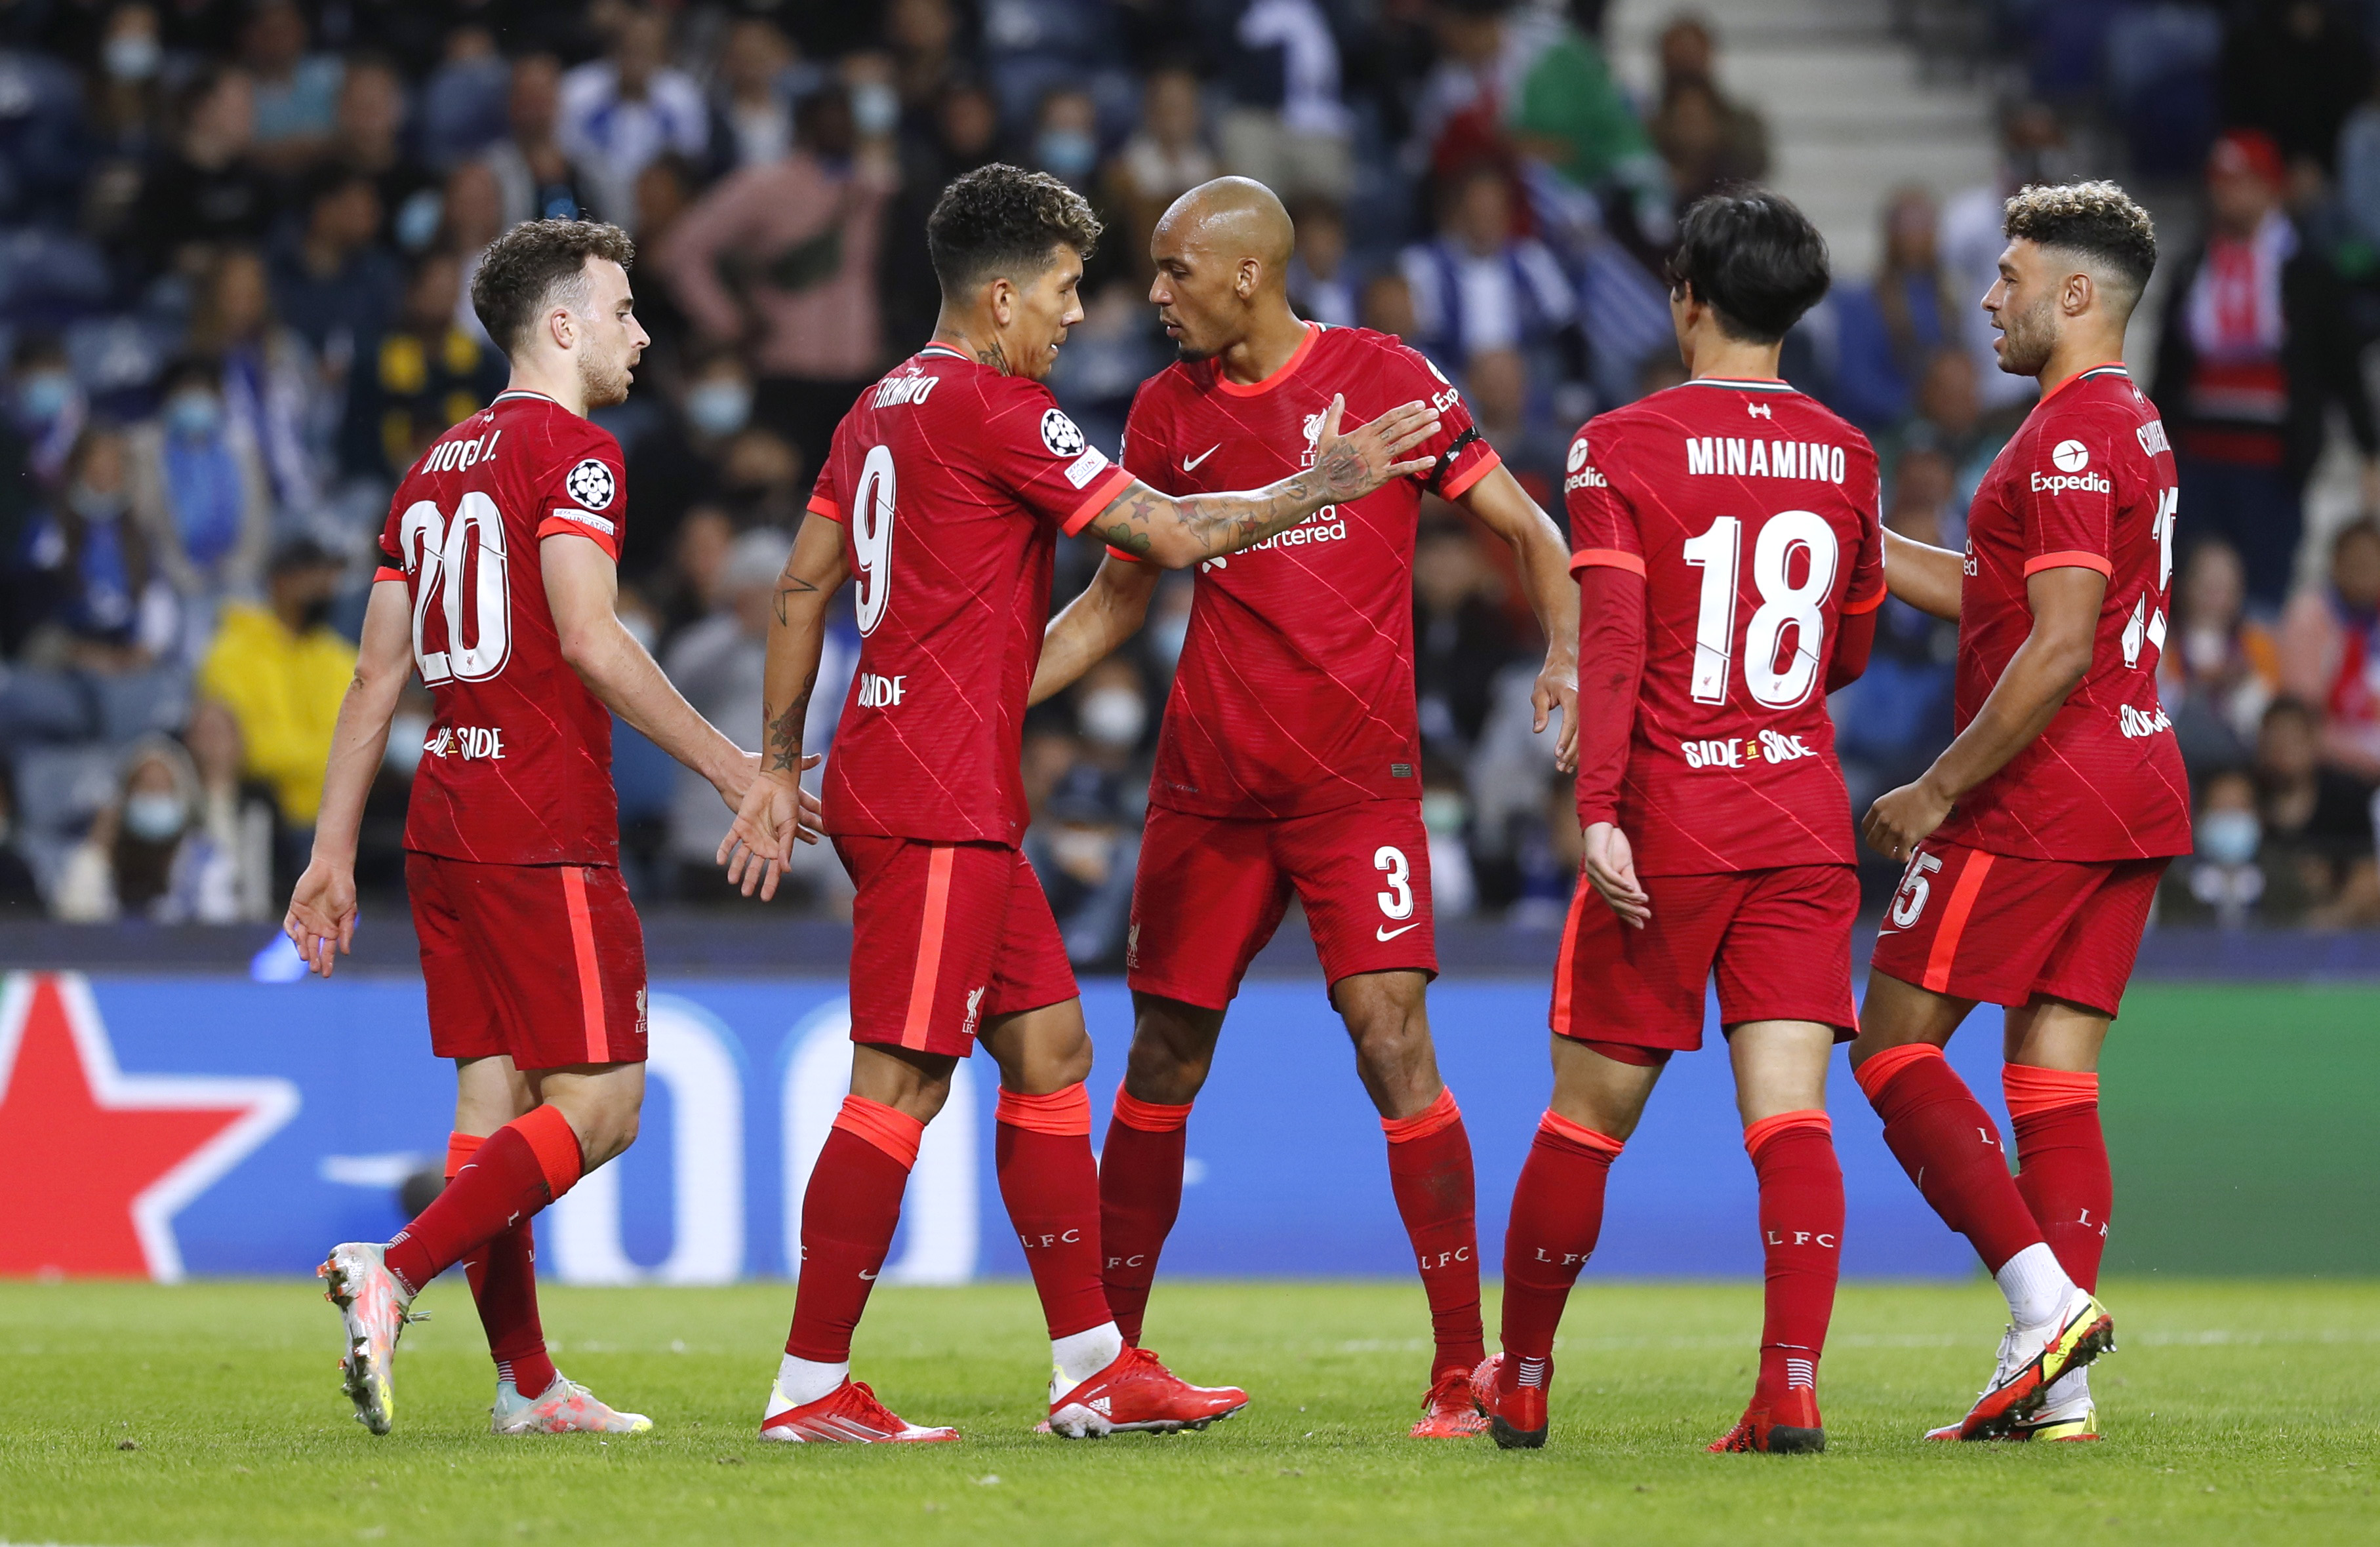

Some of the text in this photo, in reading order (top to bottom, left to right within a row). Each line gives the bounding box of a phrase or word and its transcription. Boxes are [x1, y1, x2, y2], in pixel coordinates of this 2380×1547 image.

[1432, 388, 1460, 412] Exp
[481, 430, 502, 462] J.
[1686, 437, 1846, 485] MINAMINO
[2030, 471, 2110, 496] Expedia
[852, 445, 897, 638] 9
[401, 492, 512, 687] 20
[1683, 510, 1838, 710] 18
[457, 727, 506, 761] SIDE
[1681, 738, 1745, 769] SIDE
[1758, 729, 1818, 764] SIDE
[1374, 845, 1414, 919] 3
[1892, 847, 1943, 929] 5
[1767, 1231, 1834, 1248] LFC
[1106, 1255, 1144, 1270] FC
